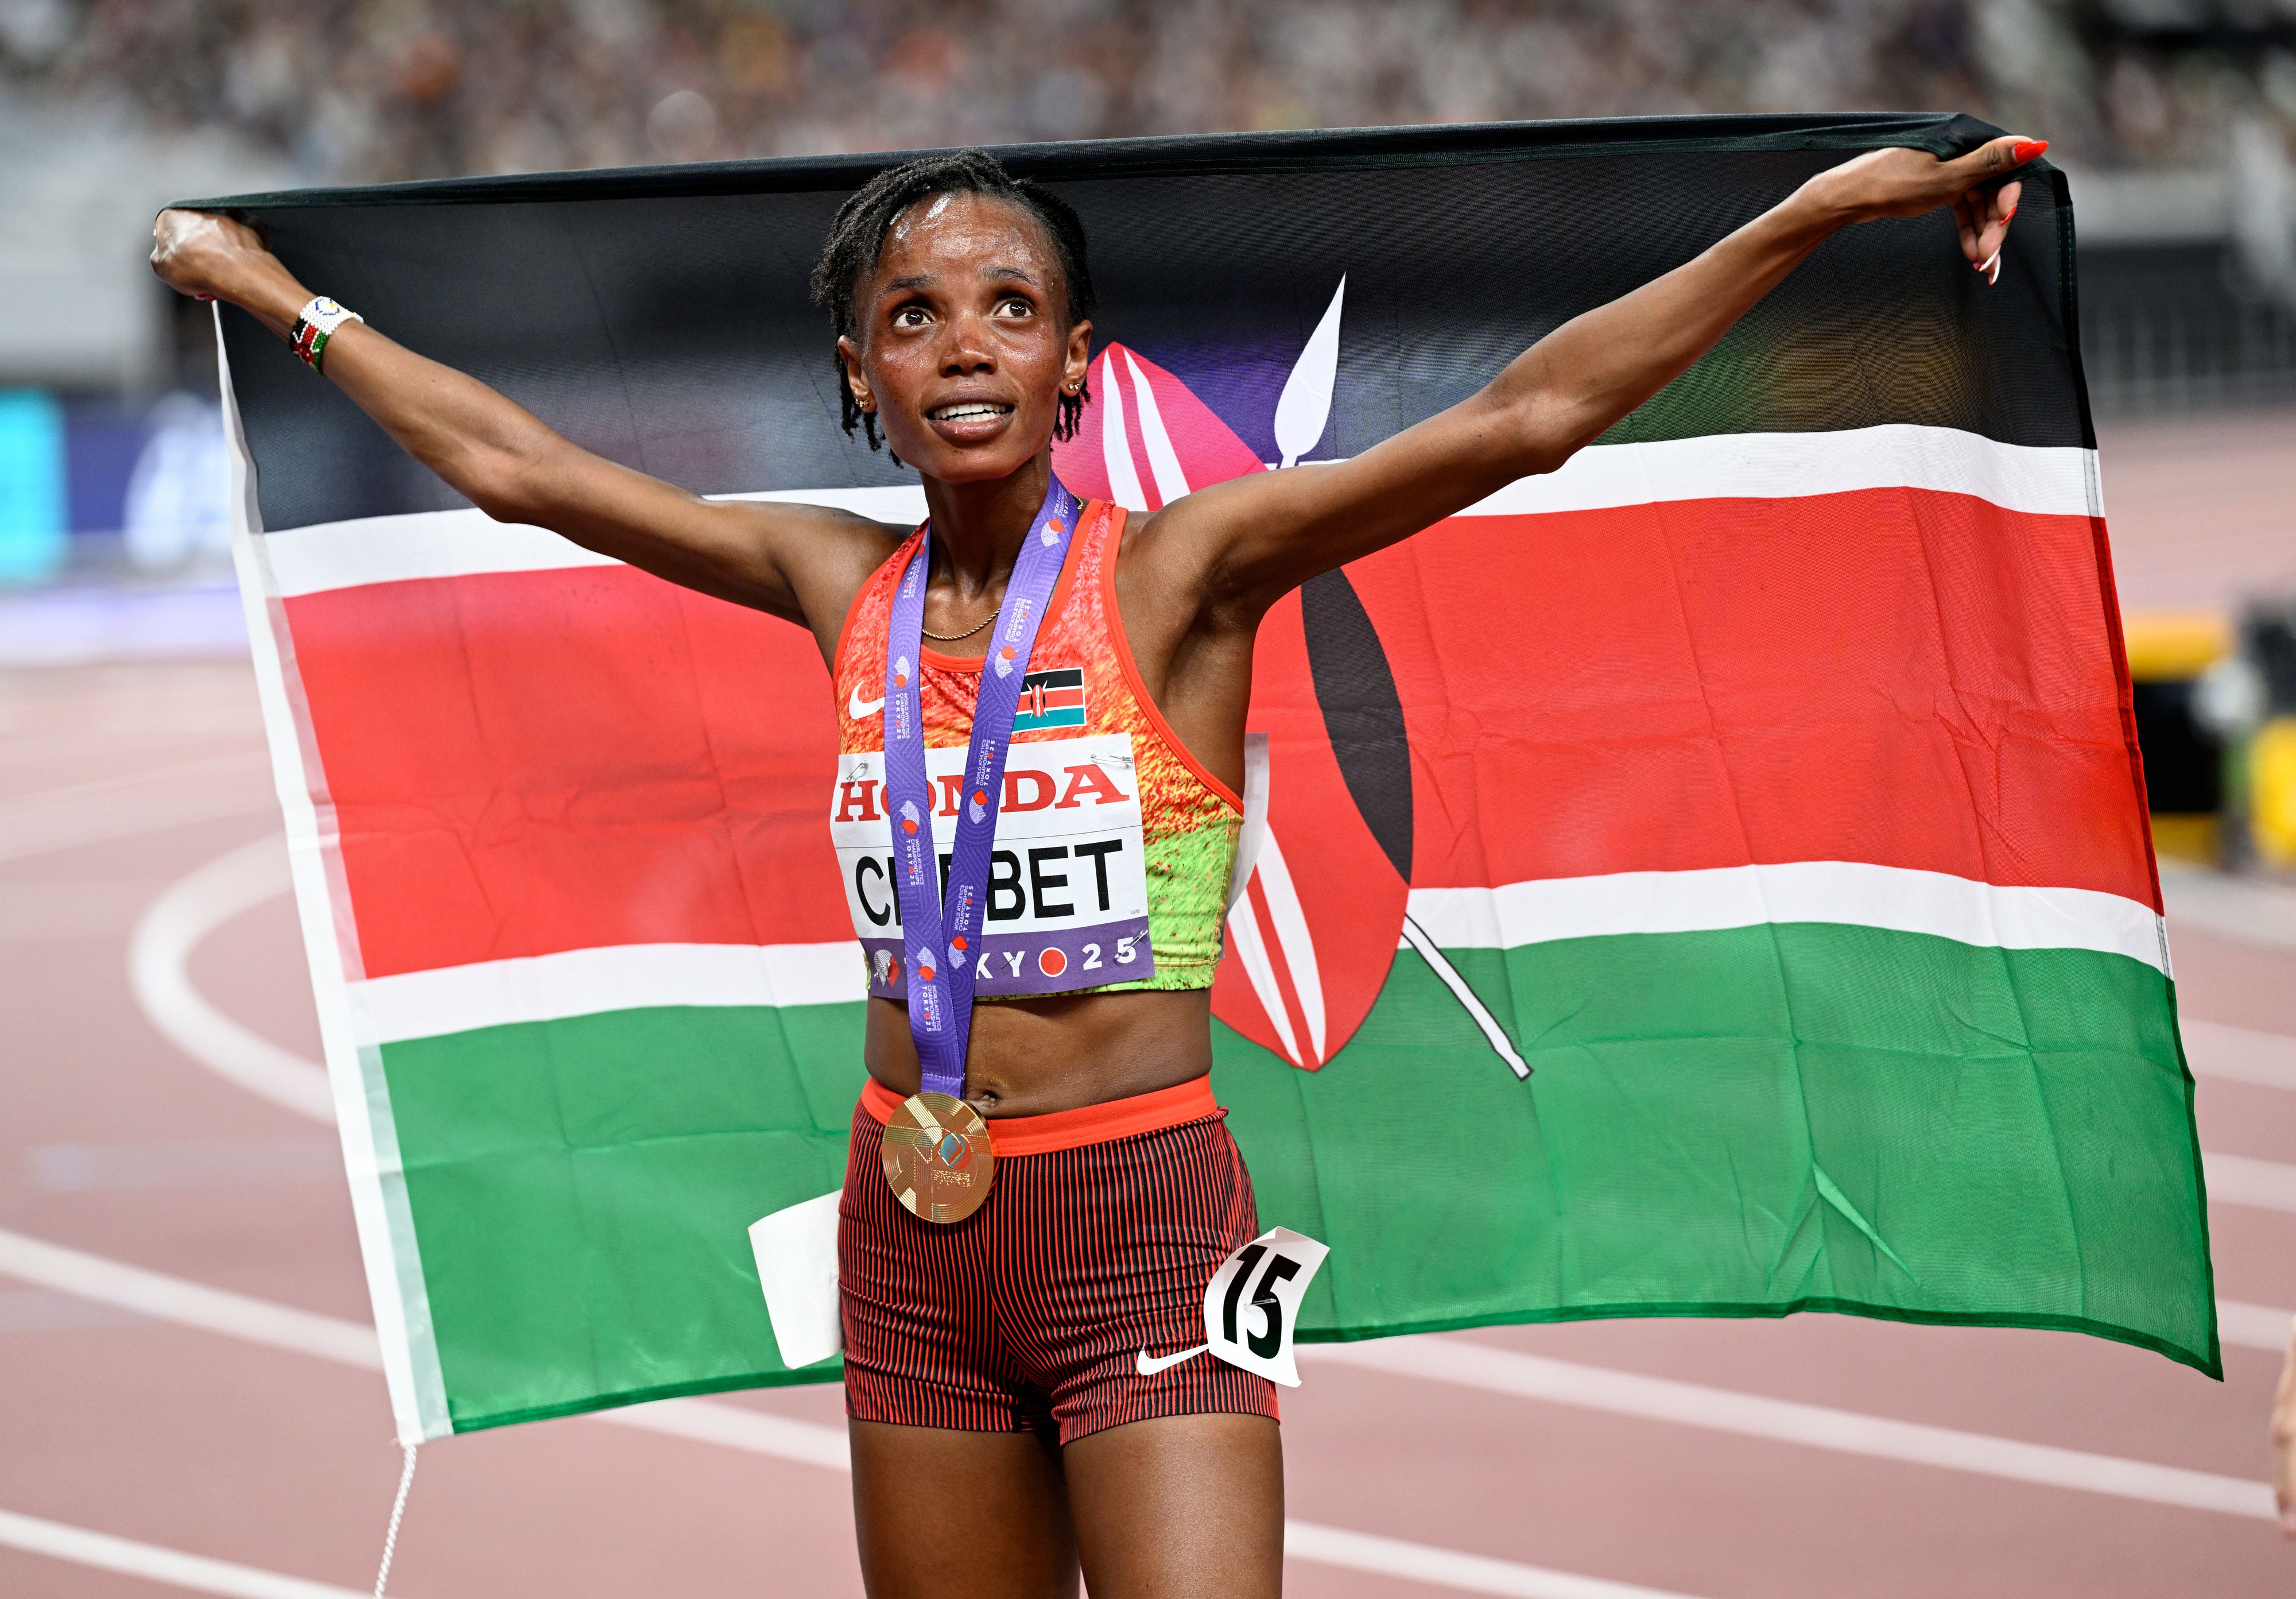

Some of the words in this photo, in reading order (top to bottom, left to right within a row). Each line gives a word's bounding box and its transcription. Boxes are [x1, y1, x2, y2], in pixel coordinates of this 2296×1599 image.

[1004, 623, 1014, 641] WORLD
[1010, 597, 1022, 623] ATHLETICS
[1009, 598, 1026, 642] CHAMPIONSHIPS
[979, 740, 991, 785] CHAMPIONSHIPS
[855, 839, 1123, 926] CBET
[910, 839, 920, 885] CHAMPIONSHIPS
[959, 885, 969, 931] CHAMPIONSHIPS
[1083, 936, 1137, 970] 25
[927, 985, 937, 1032] CHAMPIONSHIPS
[1223, 1244, 1302, 1359] 15
